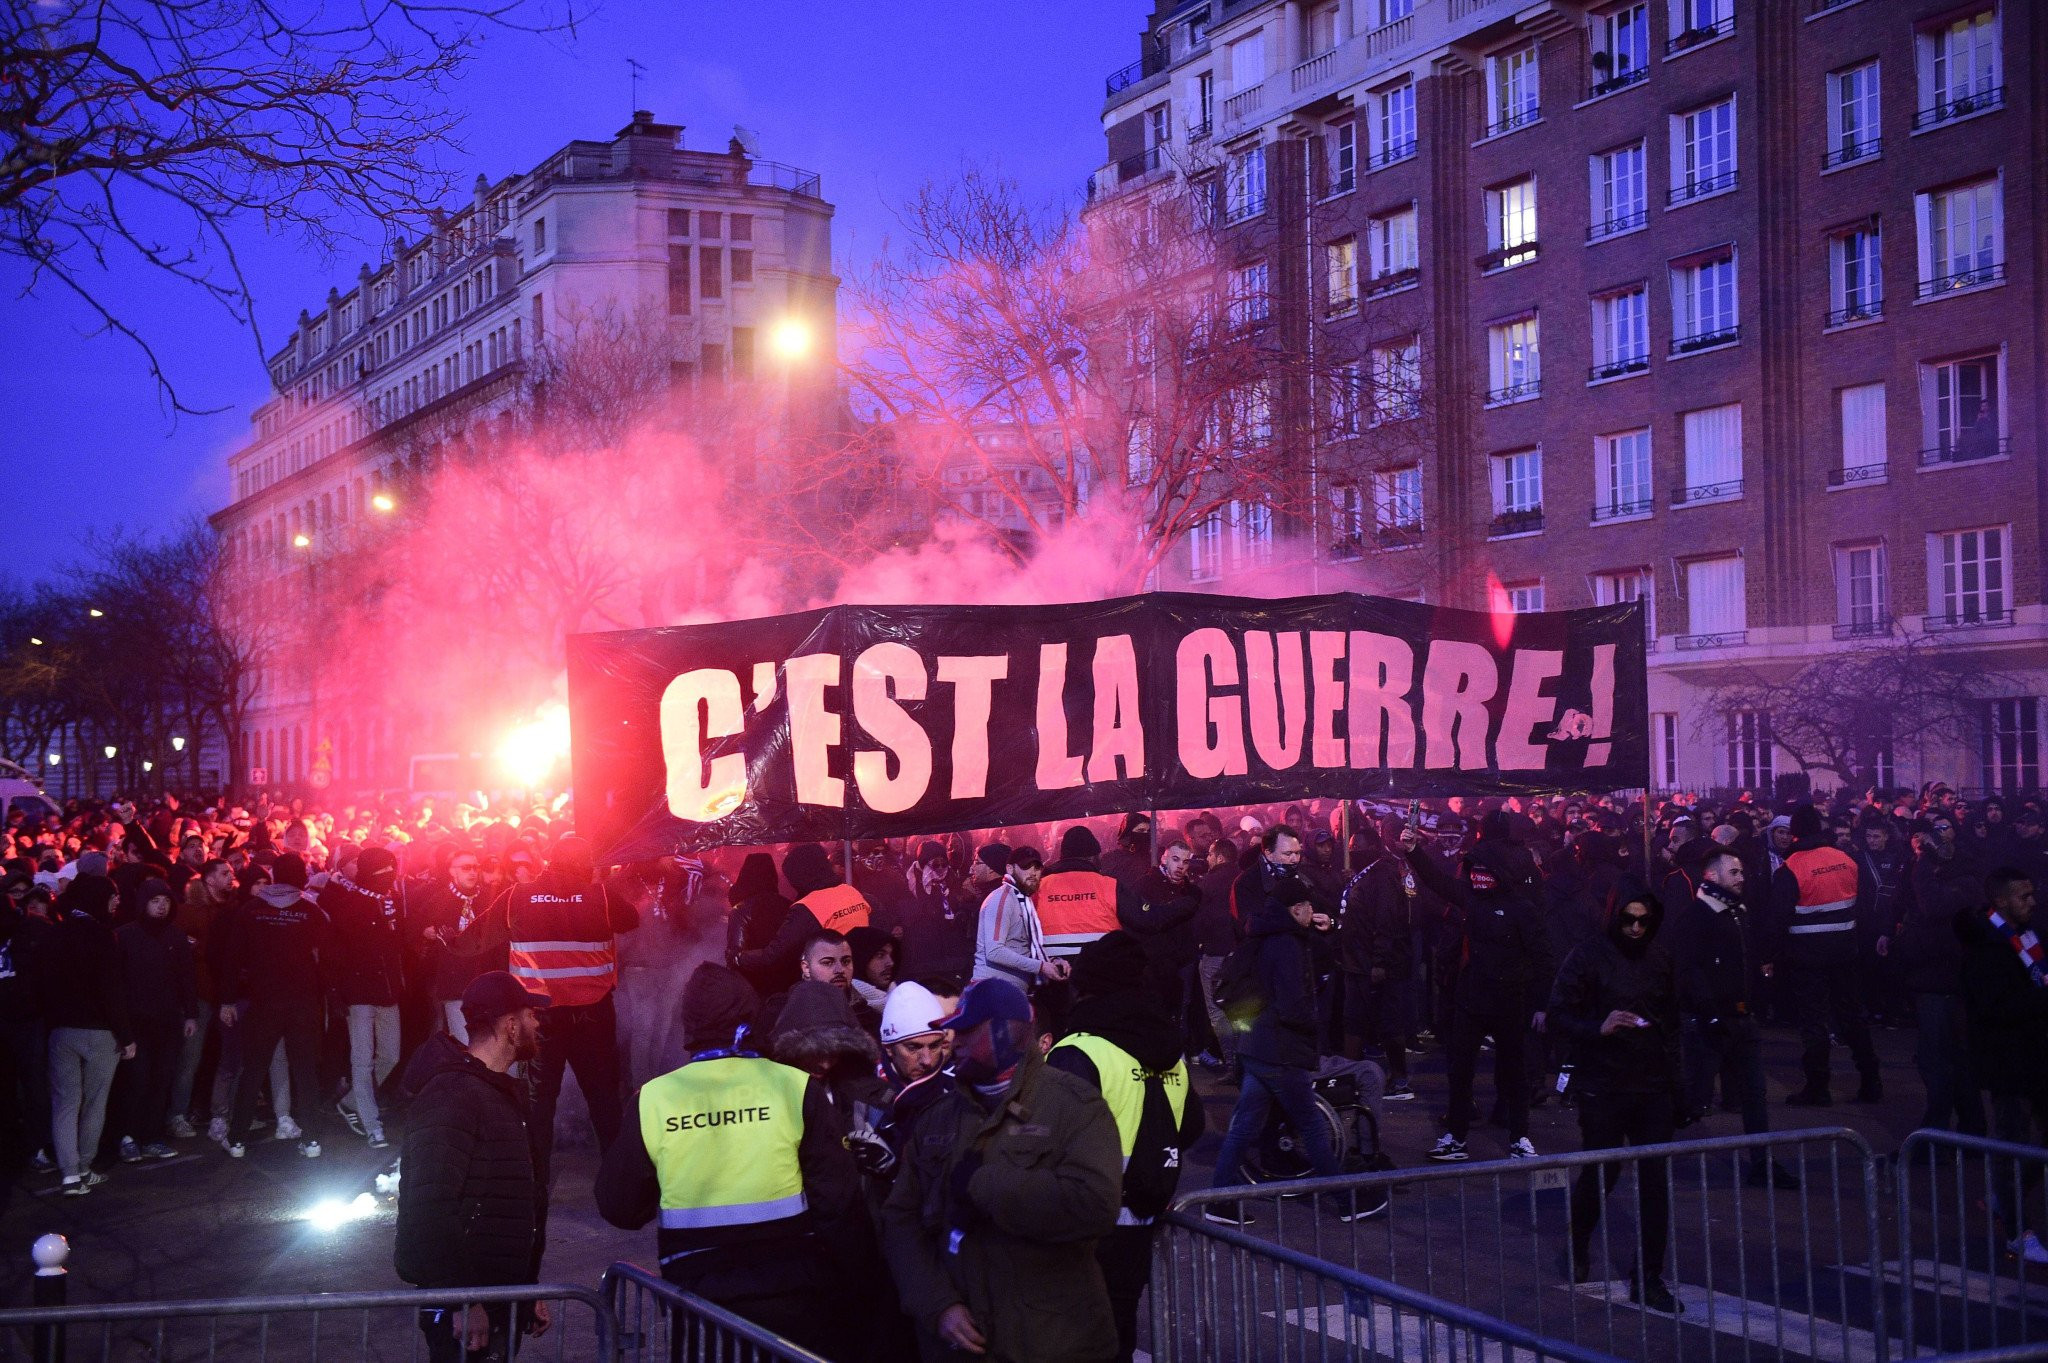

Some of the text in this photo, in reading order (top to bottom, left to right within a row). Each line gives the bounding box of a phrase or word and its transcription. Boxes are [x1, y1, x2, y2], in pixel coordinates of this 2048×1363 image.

[659, 641, 1009, 822] C'EST
[1035, 633, 1145, 790] LA
[1812, 862, 1848, 876] SECURITE
[1047, 892, 1096, 903] SECURITE
[1131, 1068, 1181, 1087] SEITE
[665, 1106, 771, 1132] SECURITE
